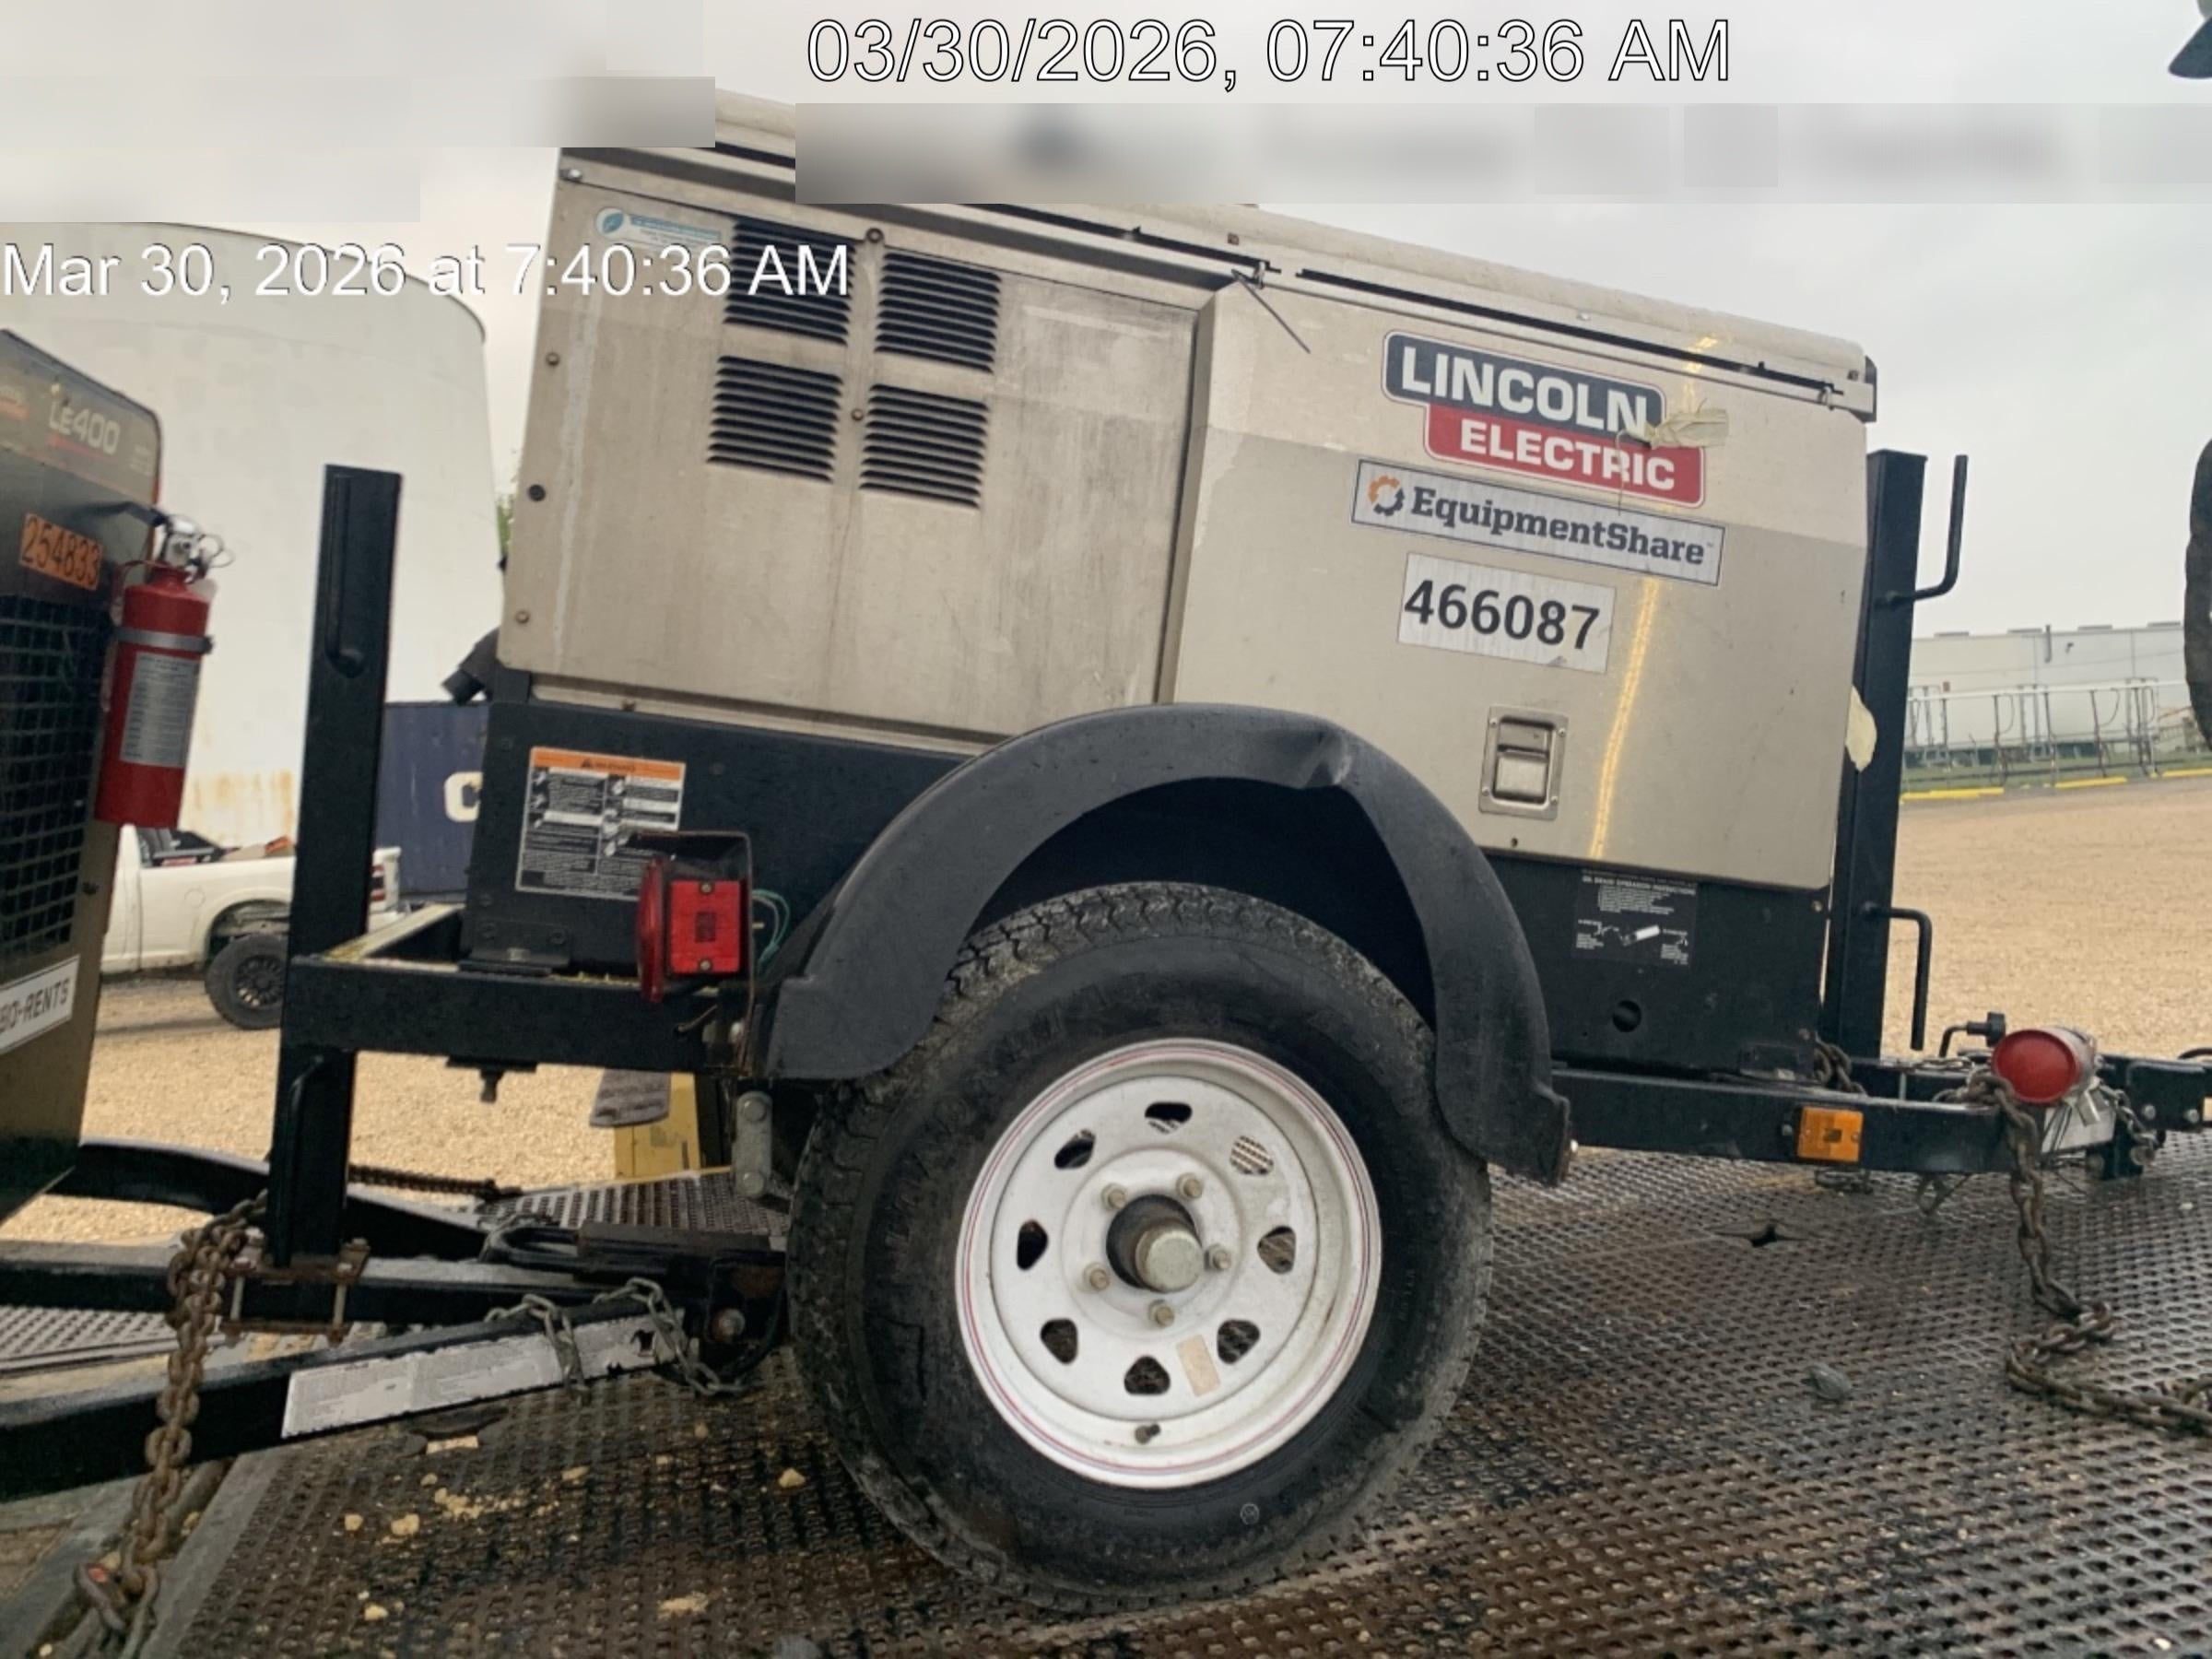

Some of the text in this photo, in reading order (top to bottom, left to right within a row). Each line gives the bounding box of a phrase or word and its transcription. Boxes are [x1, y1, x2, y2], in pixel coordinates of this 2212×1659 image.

[1401, 345, 1649, 440] LINCOLN
[1459, 418, 1676, 490] ELECTRIC
[1410, 485, 1705, 566] EquipmentShare
[1403, 578, 1601, 651] 466087
